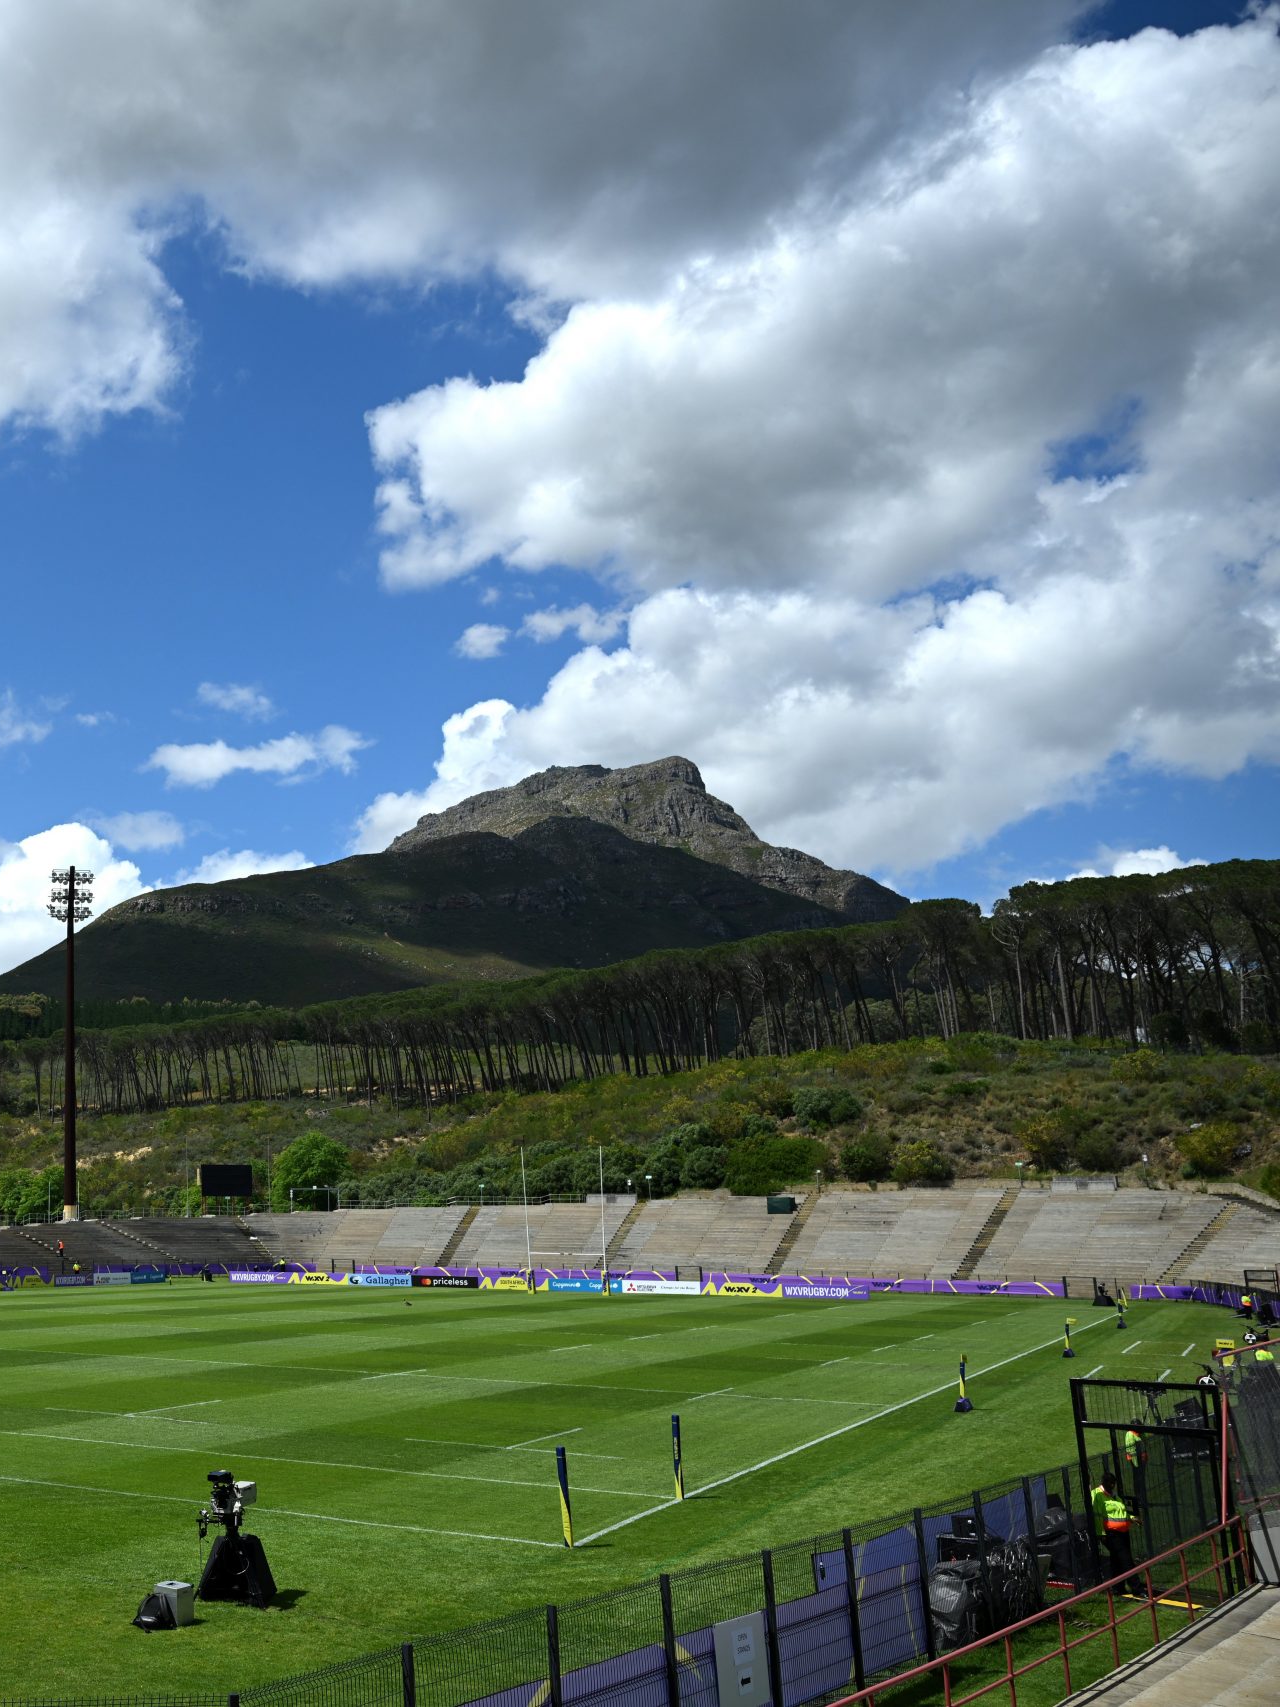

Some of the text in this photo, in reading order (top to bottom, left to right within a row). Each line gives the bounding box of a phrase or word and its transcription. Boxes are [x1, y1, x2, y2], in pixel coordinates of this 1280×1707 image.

[231, 1273, 274, 1282] WXVRUGBY.COM
[365, 1276, 409, 1286] Gallagher
[433, 1277, 468, 1286] priceless
[785, 1286, 849, 1297] WXVRUGBY.COM
